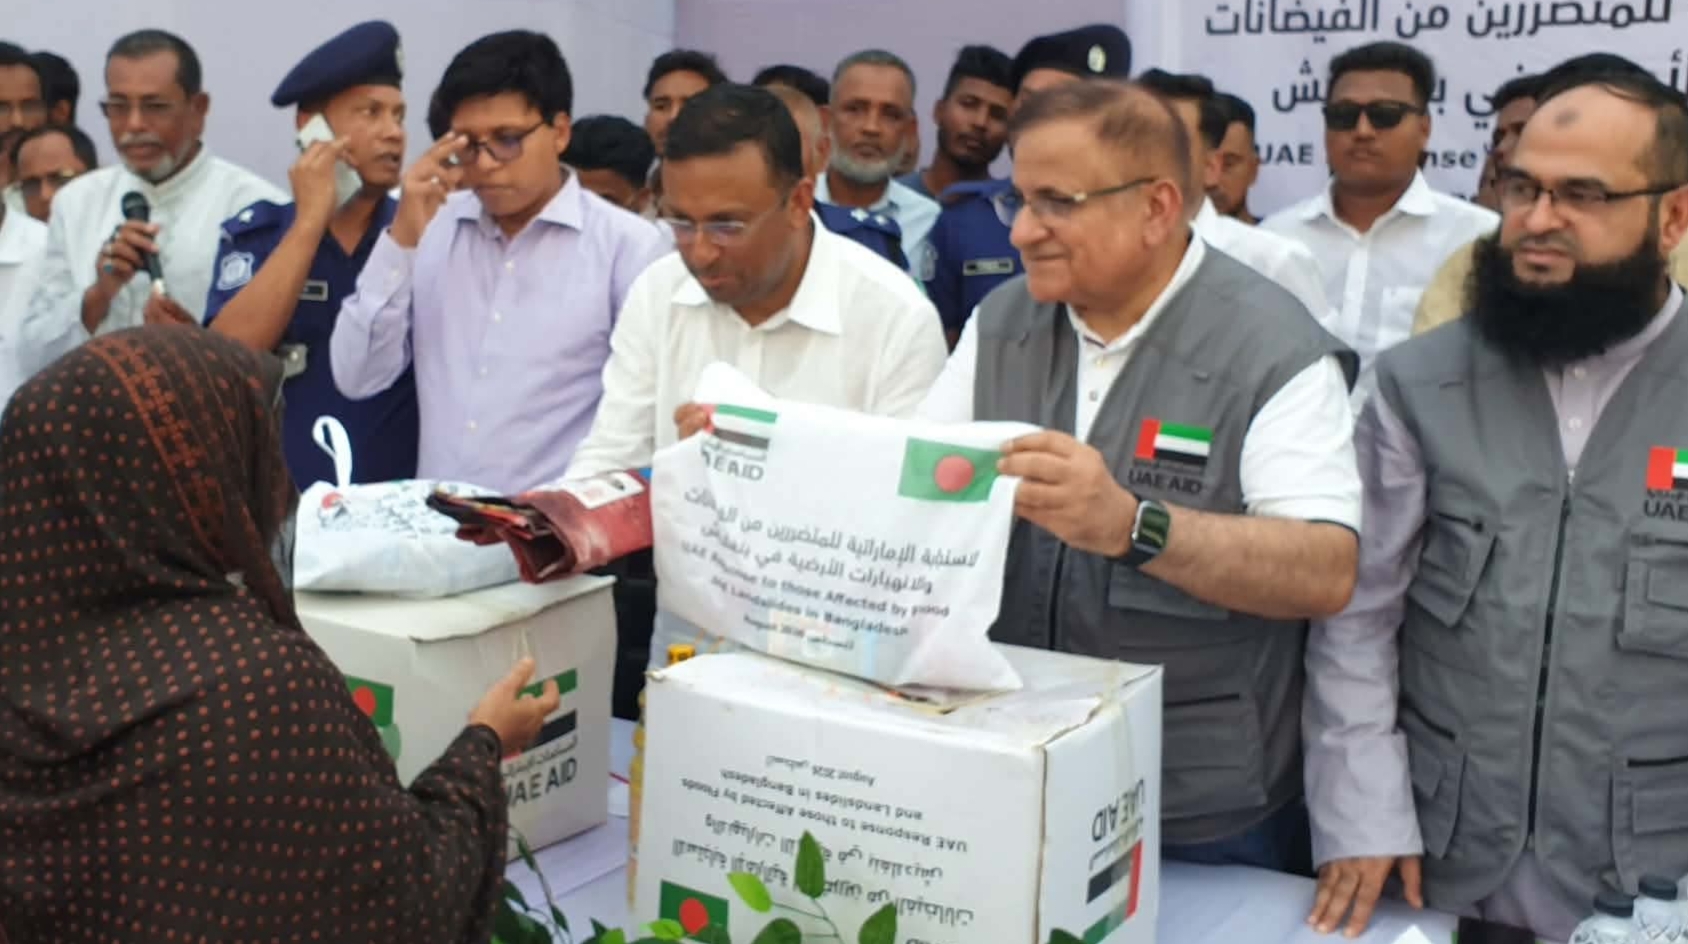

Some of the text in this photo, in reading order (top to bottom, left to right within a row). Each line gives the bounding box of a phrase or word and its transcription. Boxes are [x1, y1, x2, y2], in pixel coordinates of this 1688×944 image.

[1396, 1, 1449, 38] من
[727, 460, 765, 481] AID
[1128, 468, 1203, 494] UAE AID
[741, 517, 762, 533] من
[804, 607, 819, 619] in
[825, 590, 887, 613] Affected
[891, 600, 908, 618] by
[544, 757, 577, 795] AID
[721, 769, 923, 820] and Landslides in Bangladesh
[838, 770, 876, 787] August
[681, 778, 968, 852] UAE Response to those Affected by Floods
[1091, 798, 1120, 843] AID
[837, 845, 862, 864] في
[868, 857, 943, 885] بنغلاديش
[867, 889, 890, 903] من
[894, 897, 974, 927] الفيضانات
